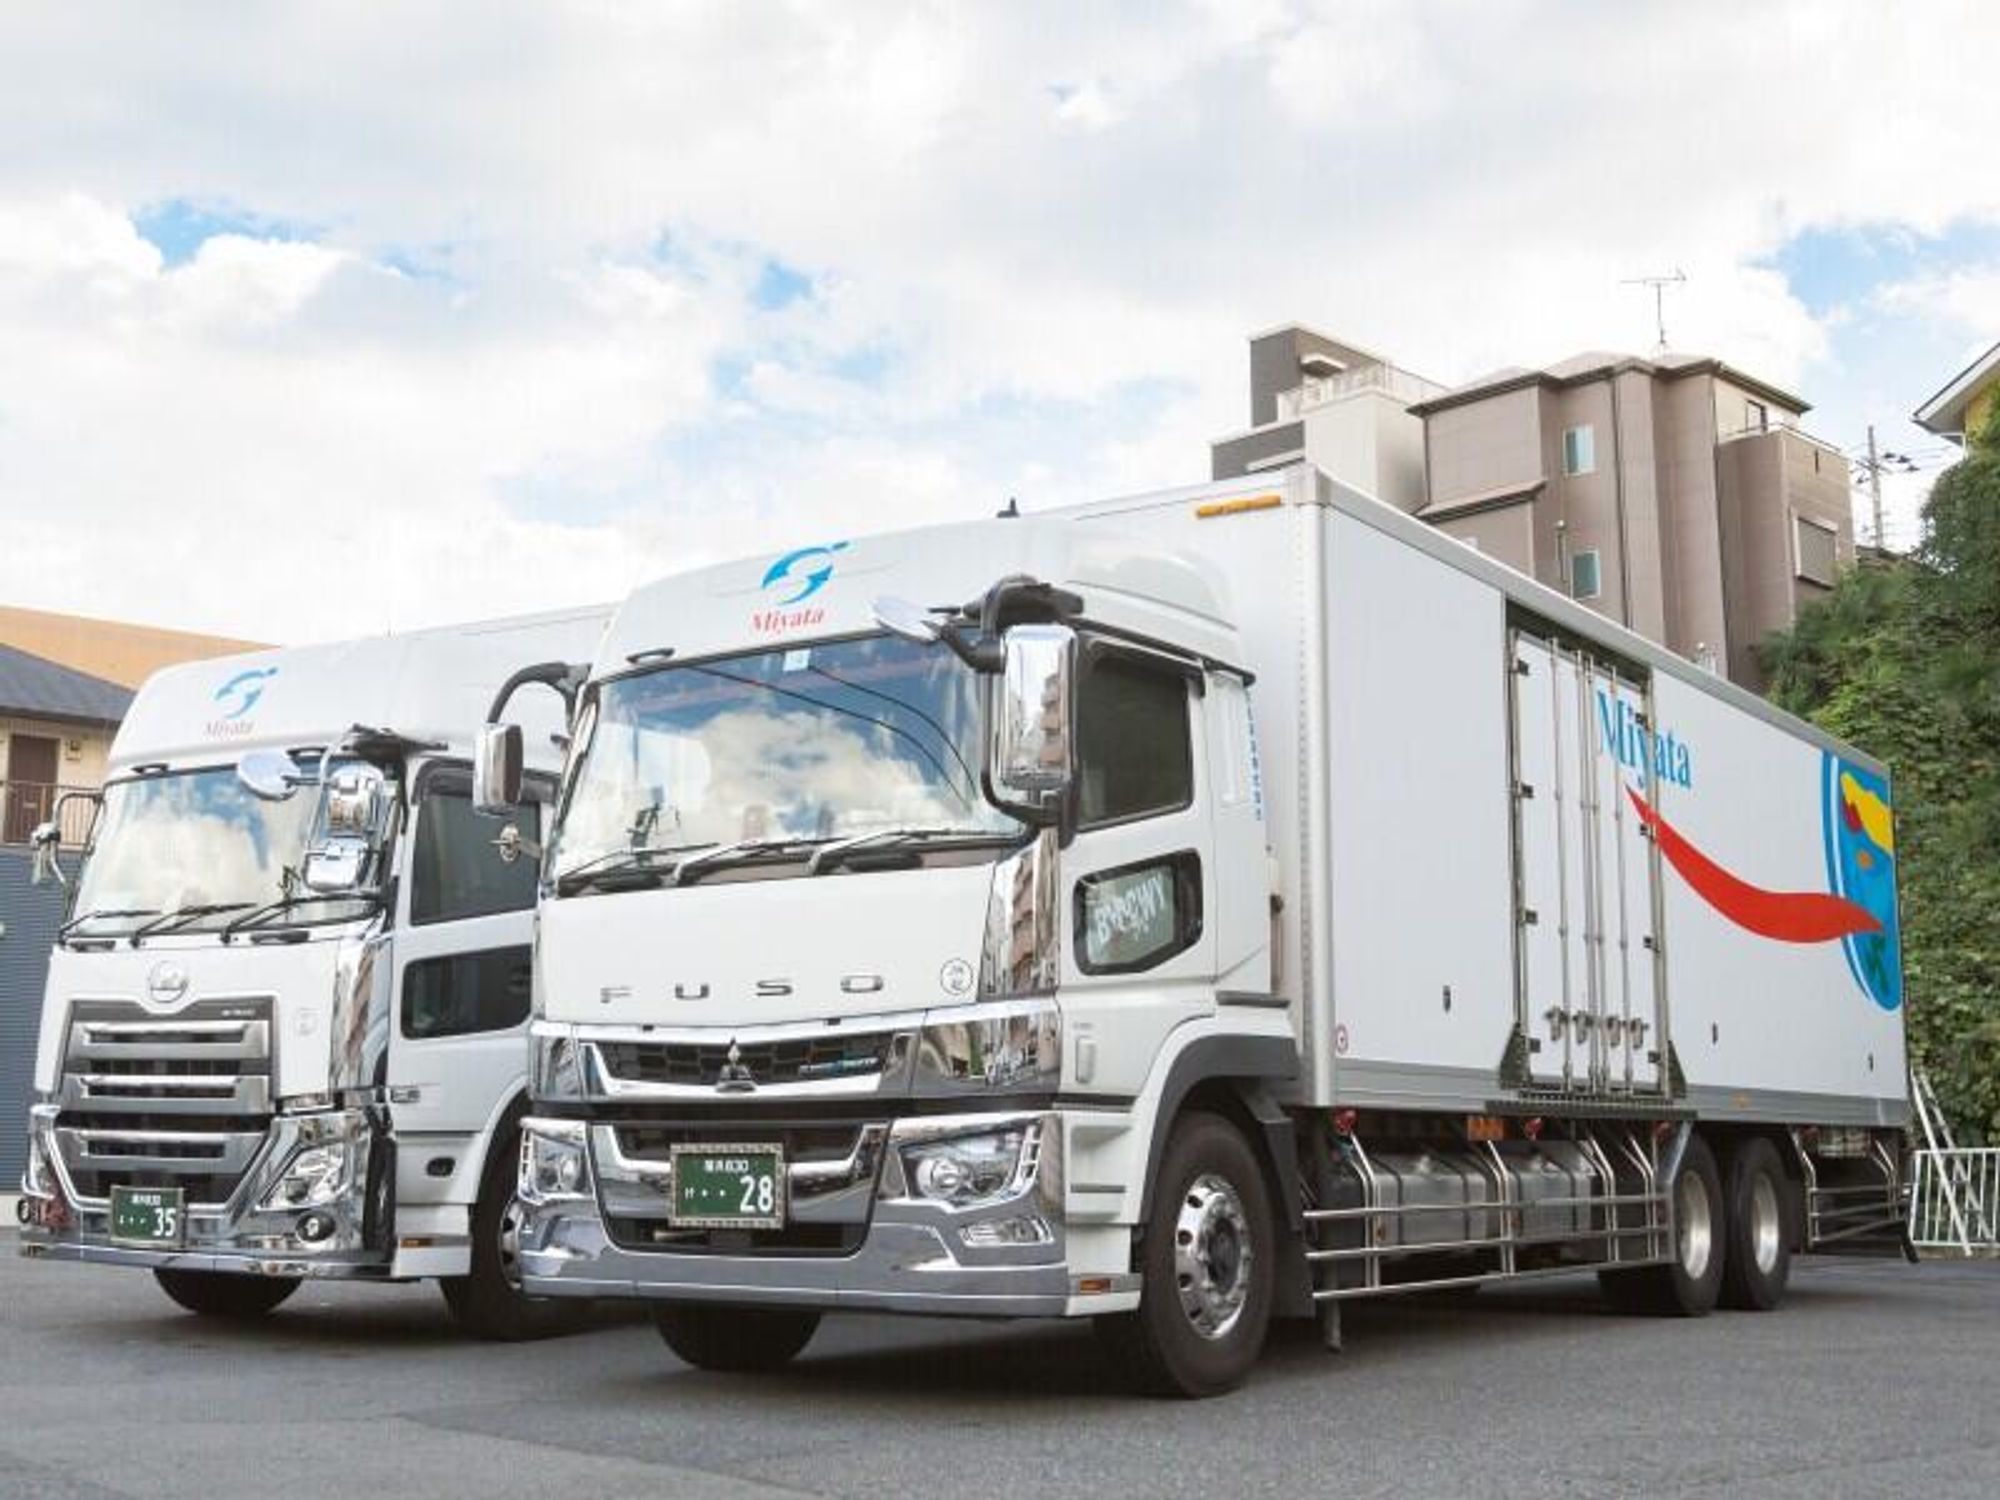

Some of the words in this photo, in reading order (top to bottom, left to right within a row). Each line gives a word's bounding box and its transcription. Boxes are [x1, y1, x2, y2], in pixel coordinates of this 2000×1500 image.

[752, 607, 825, 635] Miyata
[1597, 690, 1692, 790] Miyata
[599, 974, 884, 1003] FUSO
[739, 1174, 775, 1213] 28
[152, 1207, 177, 1237] 35
